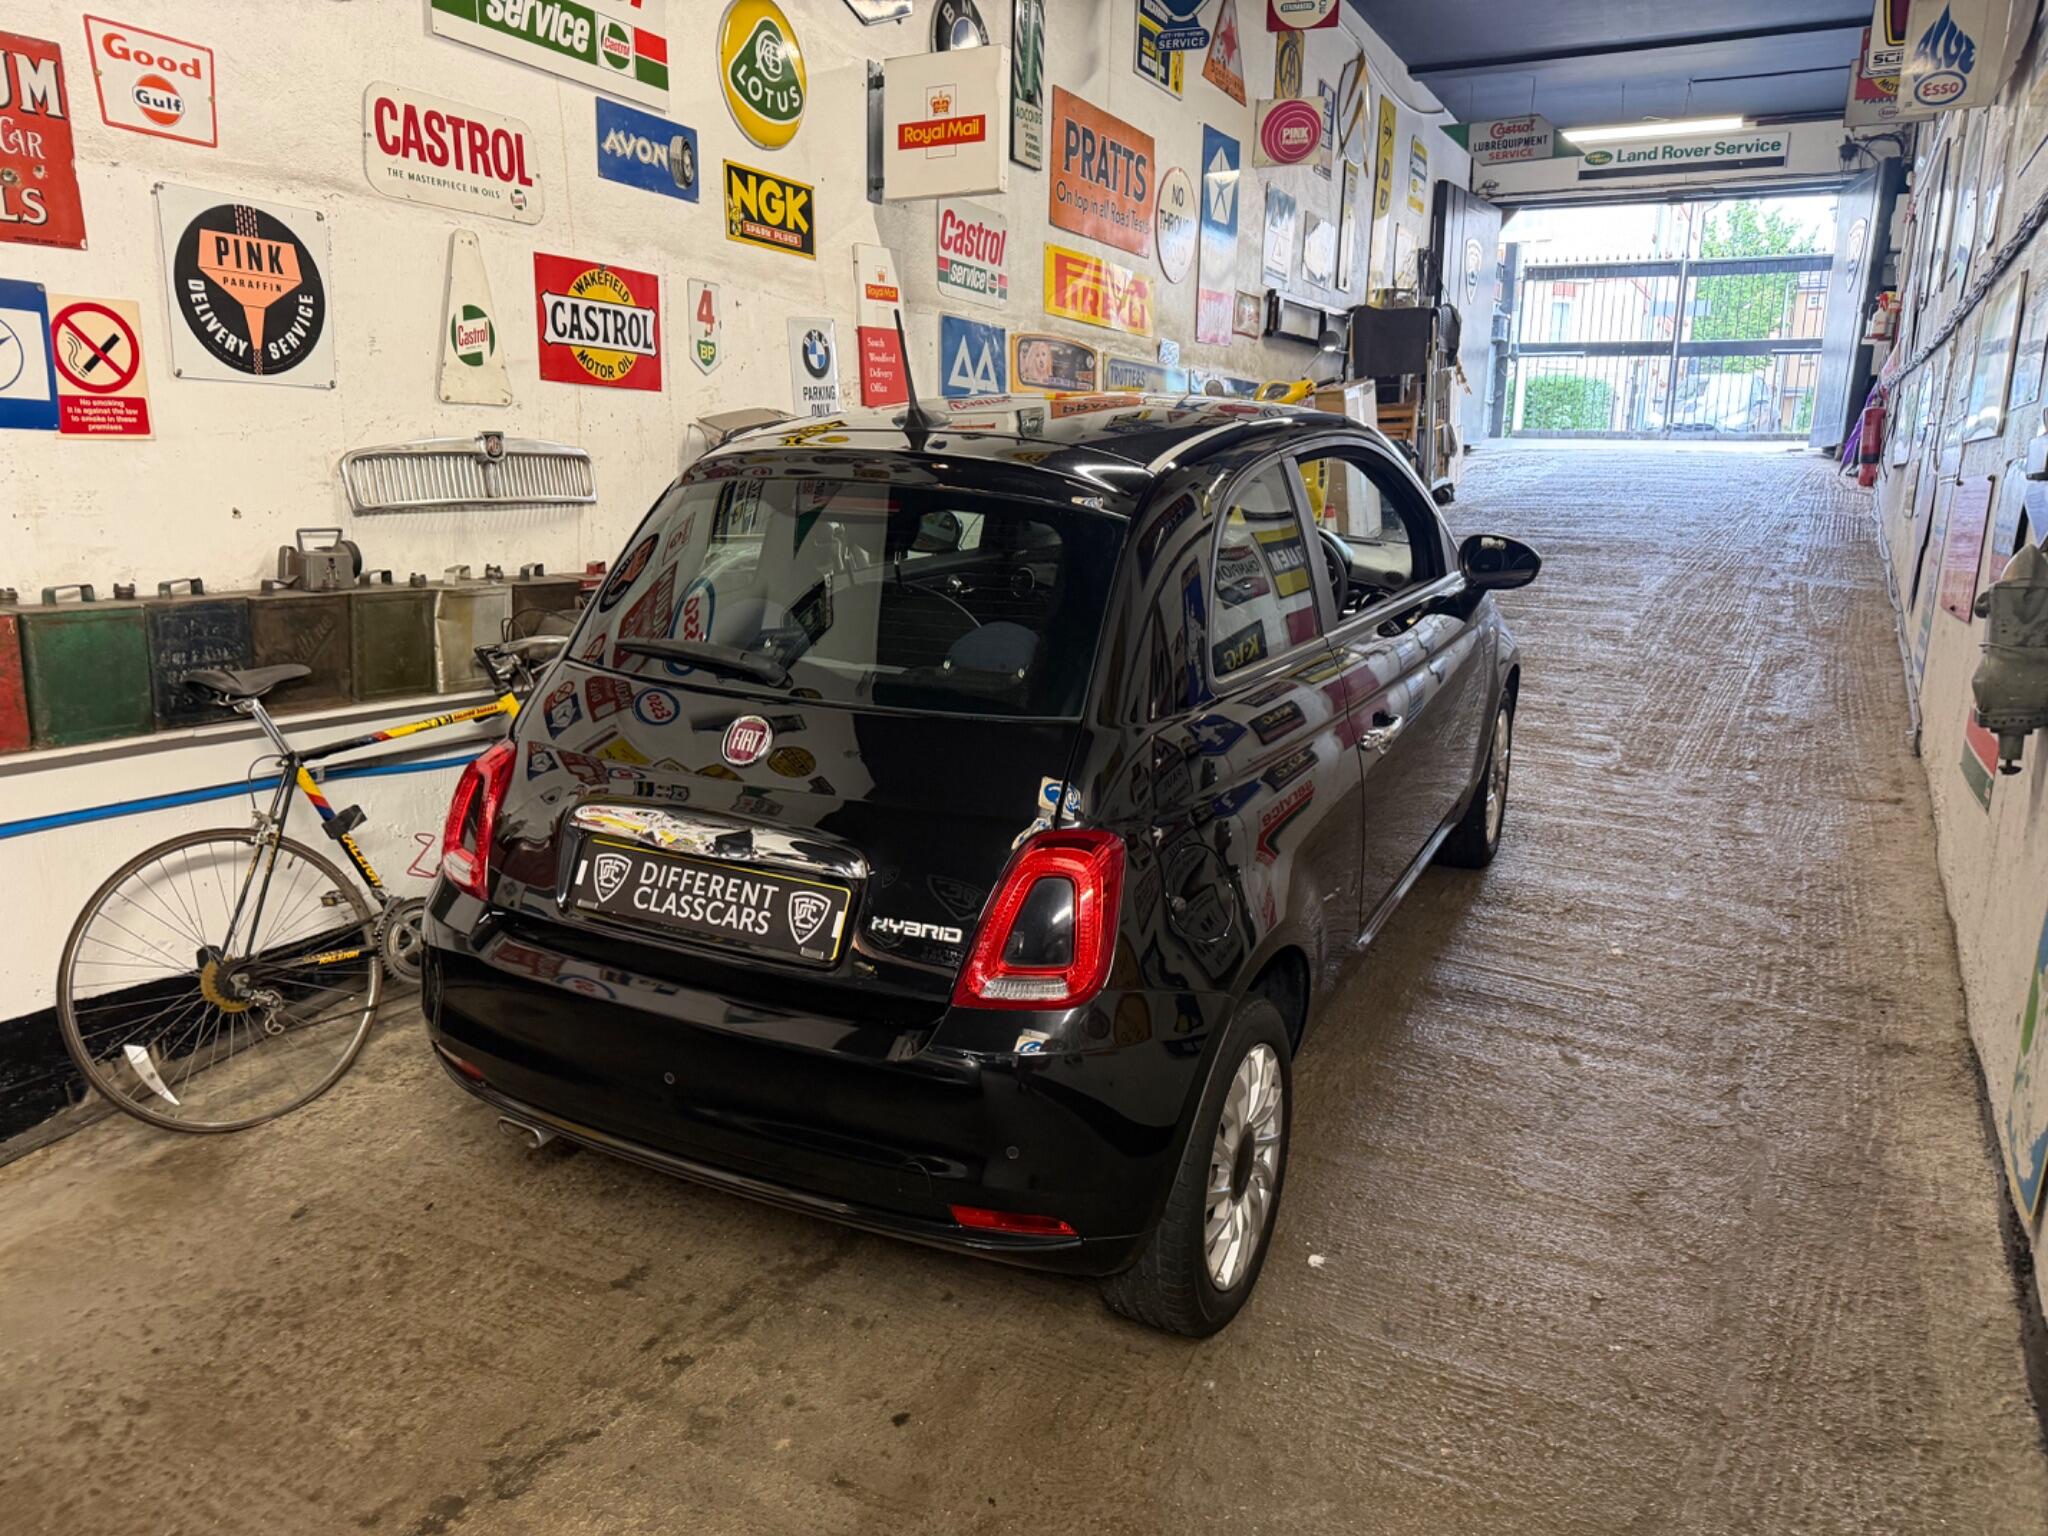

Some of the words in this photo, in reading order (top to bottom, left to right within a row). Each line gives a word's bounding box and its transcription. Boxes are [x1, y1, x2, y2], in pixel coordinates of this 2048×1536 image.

[486, 0, 591, 53] service
[1158, 37, 1205, 49] SERVICE
[102, 32, 201, 80] Good
[135, 88, 182, 113] Gulf
[736, 64, 800, 113] LOTUS
[374, 96, 533, 187] CASTROL
[904, 122, 945, 144] Royal
[947, 118, 980, 138] Mail
[1283, 126, 1309, 138] PINK
[1490, 119, 1536, 139] Castrol
[601, 128, 669, 171] AVON
[1473, 134, 1549, 152] LUBREQUIPMENT
[1488, 147, 1536, 160] SERVICE
[1617, 146, 1658, 163] Land
[1662, 144, 1712, 160] Rover
[1714, 138, 1782, 156] Service
[1063, 117, 1148, 203] PRATTS
[387, 167, 404, 179] THE
[408, 172, 467, 192] MASTERPIECE
[470, 185, 479, 194] IN
[482, 188, 500, 199] OILS
[731, 170, 809, 234] NGK
[1056, 180, 1072, 202] On
[1074, 190, 1088, 215] top
[1091, 196, 1098, 215] in
[1100, 199, 1109, 219] all
[1111, 202, 1130, 227] Road
[1131, 209, 1150, 234] Tests
[1171, 186, 1184, 208] NO
[774, 230, 798, 245] PLUGS
[940, 208, 1007, 267] Castrol
[215, 236, 284, 275] PINK
[223, 276, 282, 292] PARAFFIN
[573, 270, 630, 303] WAKEFIELD
[950, 262, 986, 291] service
[188, 279, 248, 357] DELIVERY
[268, 294, 314, 360] SERVICE
[551, 301, 653, 349] CASTROL
[697, 289, 715, 337] 4
[458, 321, 488, 346] Castrol
[577, 349, 615, 378] MOTOR
[618, 355, 633, 374] OIL
[699, 344, 714, 360] BP
[868, 352, 896, 363] Woodford
[948, 335, 999, 394] AA
[870, 368, 893, 380] Delivery
[803, 385, 836, 401] PARKING
[870, 383, 888, 393] Office
[79, 398, 91, 406] No
[92, 400, 125, 408] smoking
[83, 408, 111, 416] against
[812, 403, 831, 417] ONLY
[88, 424, 123, 432] premises
[116, 415, 137, 423] these
[731, 728, 764, 752] FIAT
[640, 861, 779, 909] DIFFERENT
[633, 887, 772, 935] CLASSCARS
[871, 916, 963, 943] HYBRID
